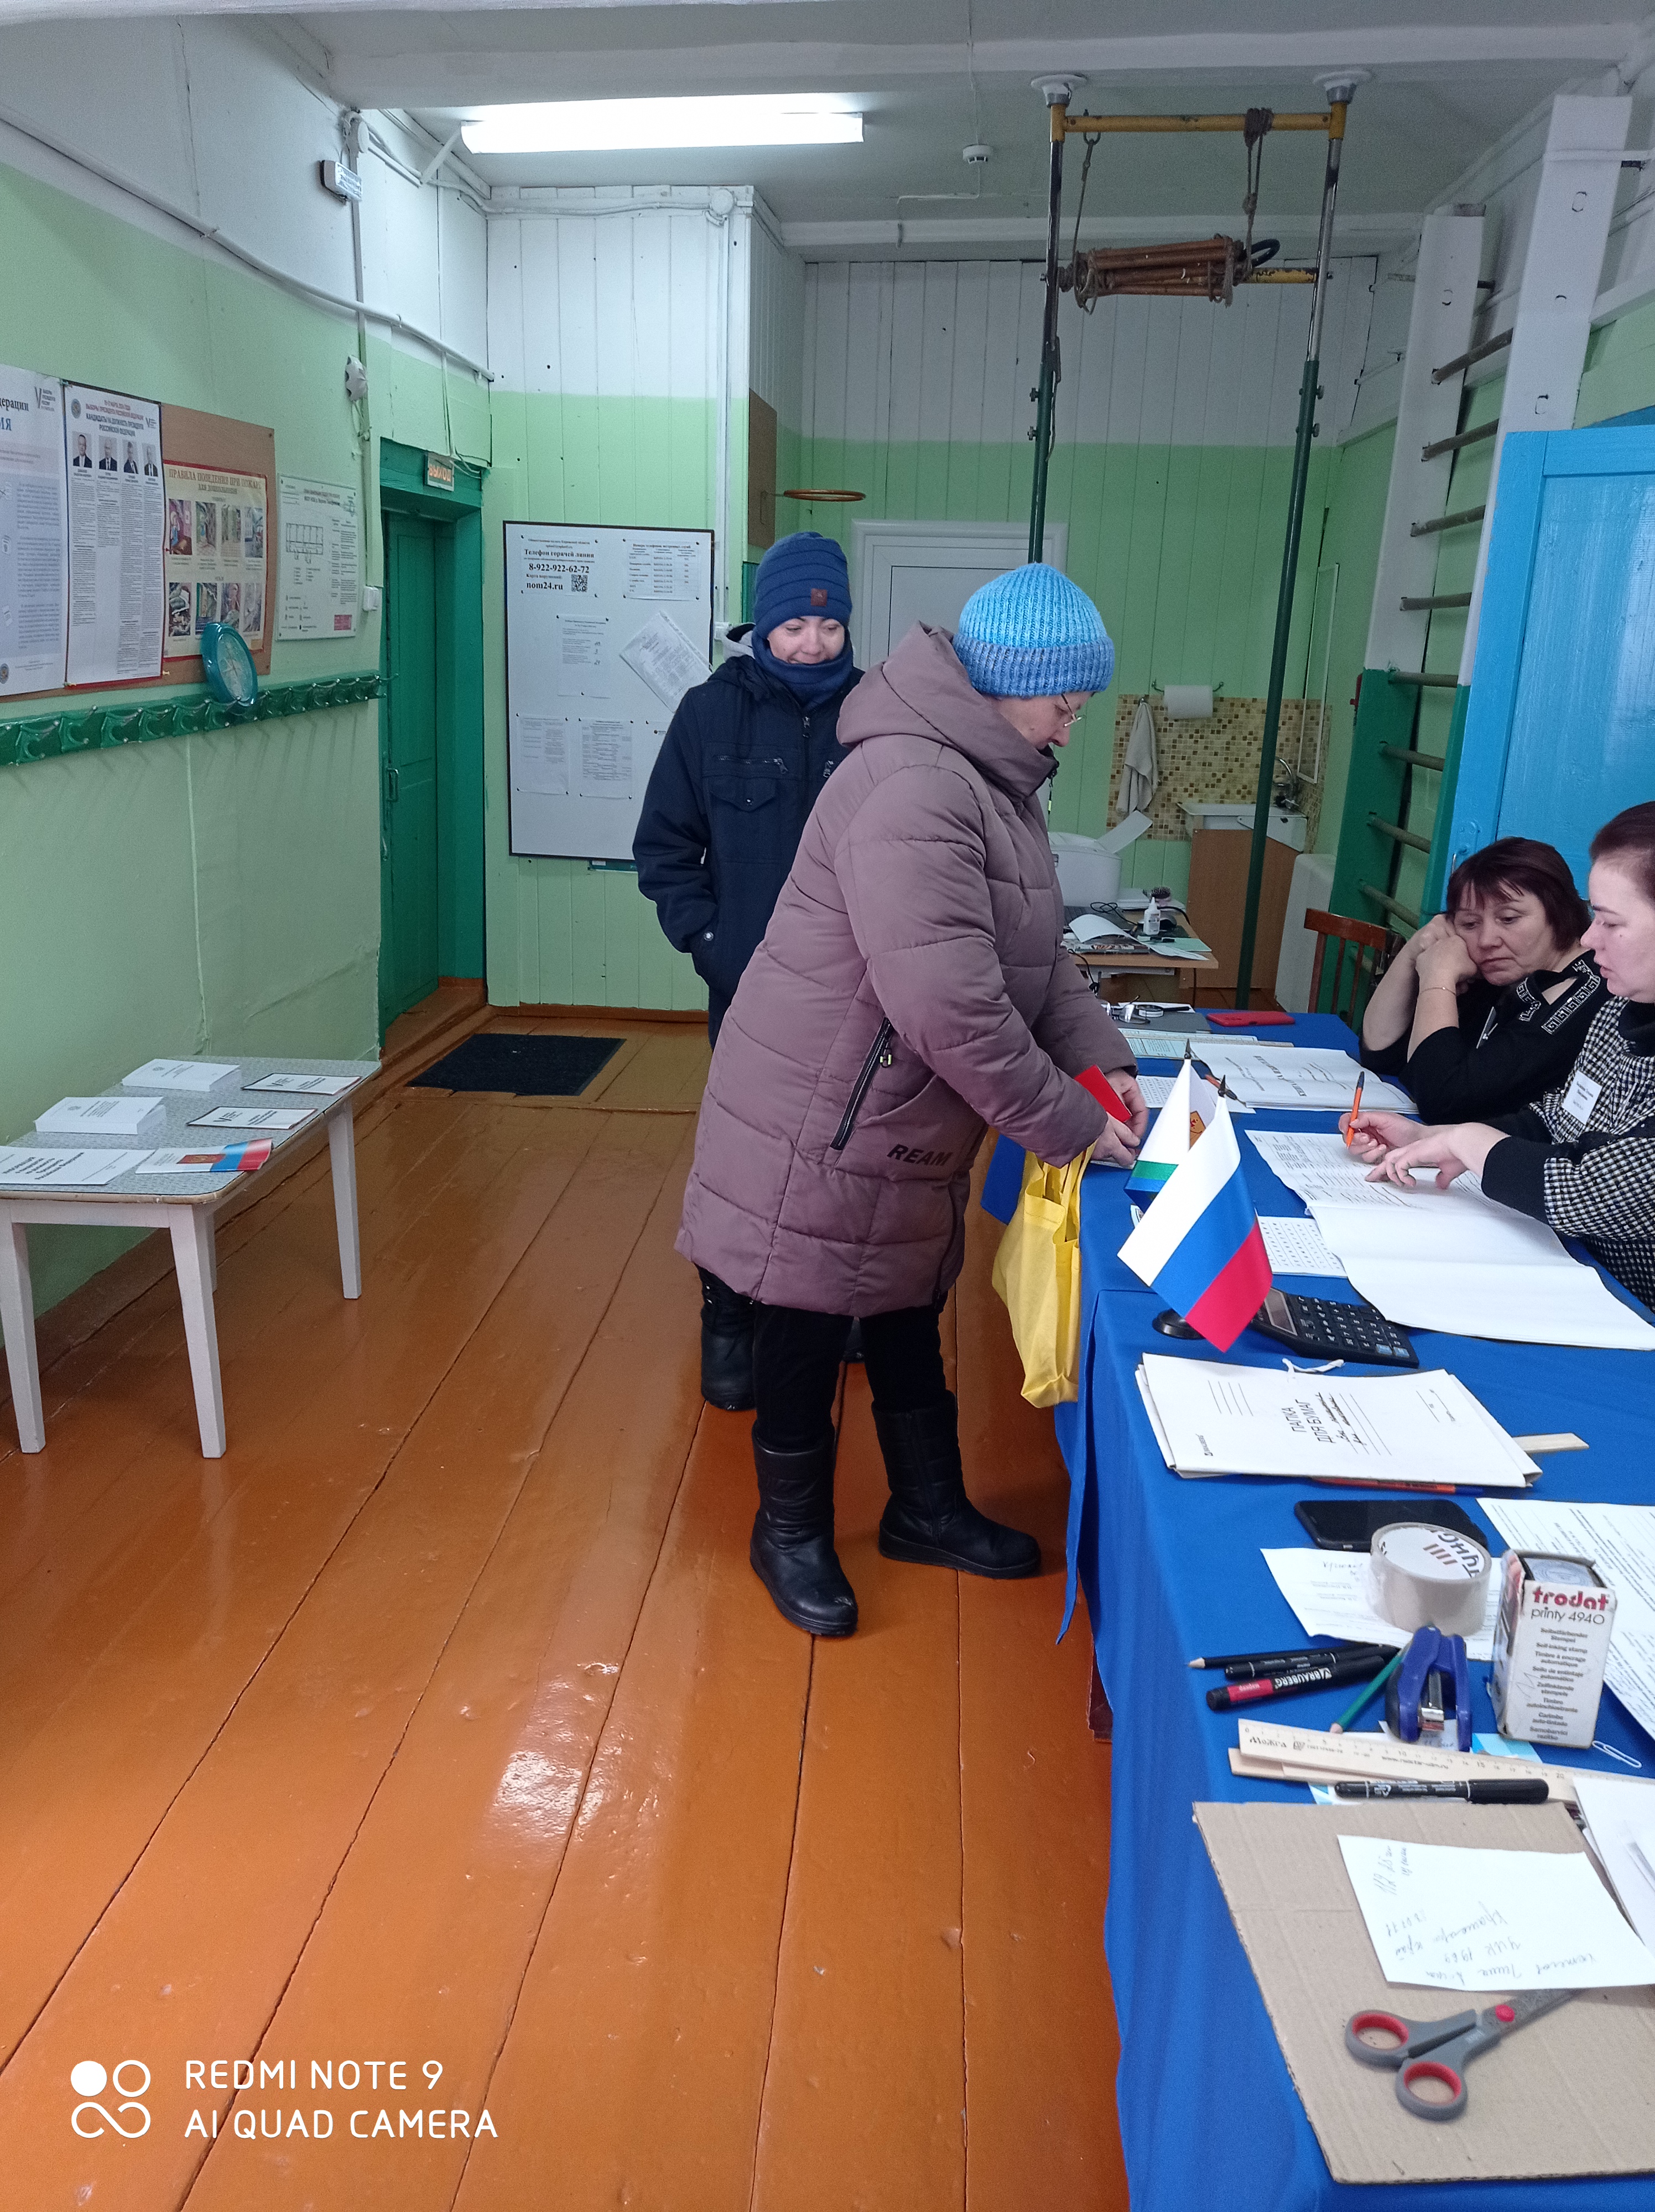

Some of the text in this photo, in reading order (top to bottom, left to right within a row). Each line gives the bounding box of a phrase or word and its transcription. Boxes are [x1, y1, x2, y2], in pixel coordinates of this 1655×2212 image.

[169, 469, 196, 481] ПРАВИЛА
[429, 463, 451, 482] ВЫХОД
[524, 549, 549, 557] Телефон
[529, 563, 590, 573] 8-922-922-62-72
[527, 582, 564, 590] nom24.ru
[1282, 1407, 1307, 1433] ПАПКА
[1295, 1399, 1336, 1443] ДЛЯ БУМАГ
[1532, 1585, 1609, 1611] trodat
[1531, 1606, 1605, 1625] printy 4940
[1550, 1635, 1576, 1643] Stempel
[1274, 1670, 1321, 1688] BRAUBERG
